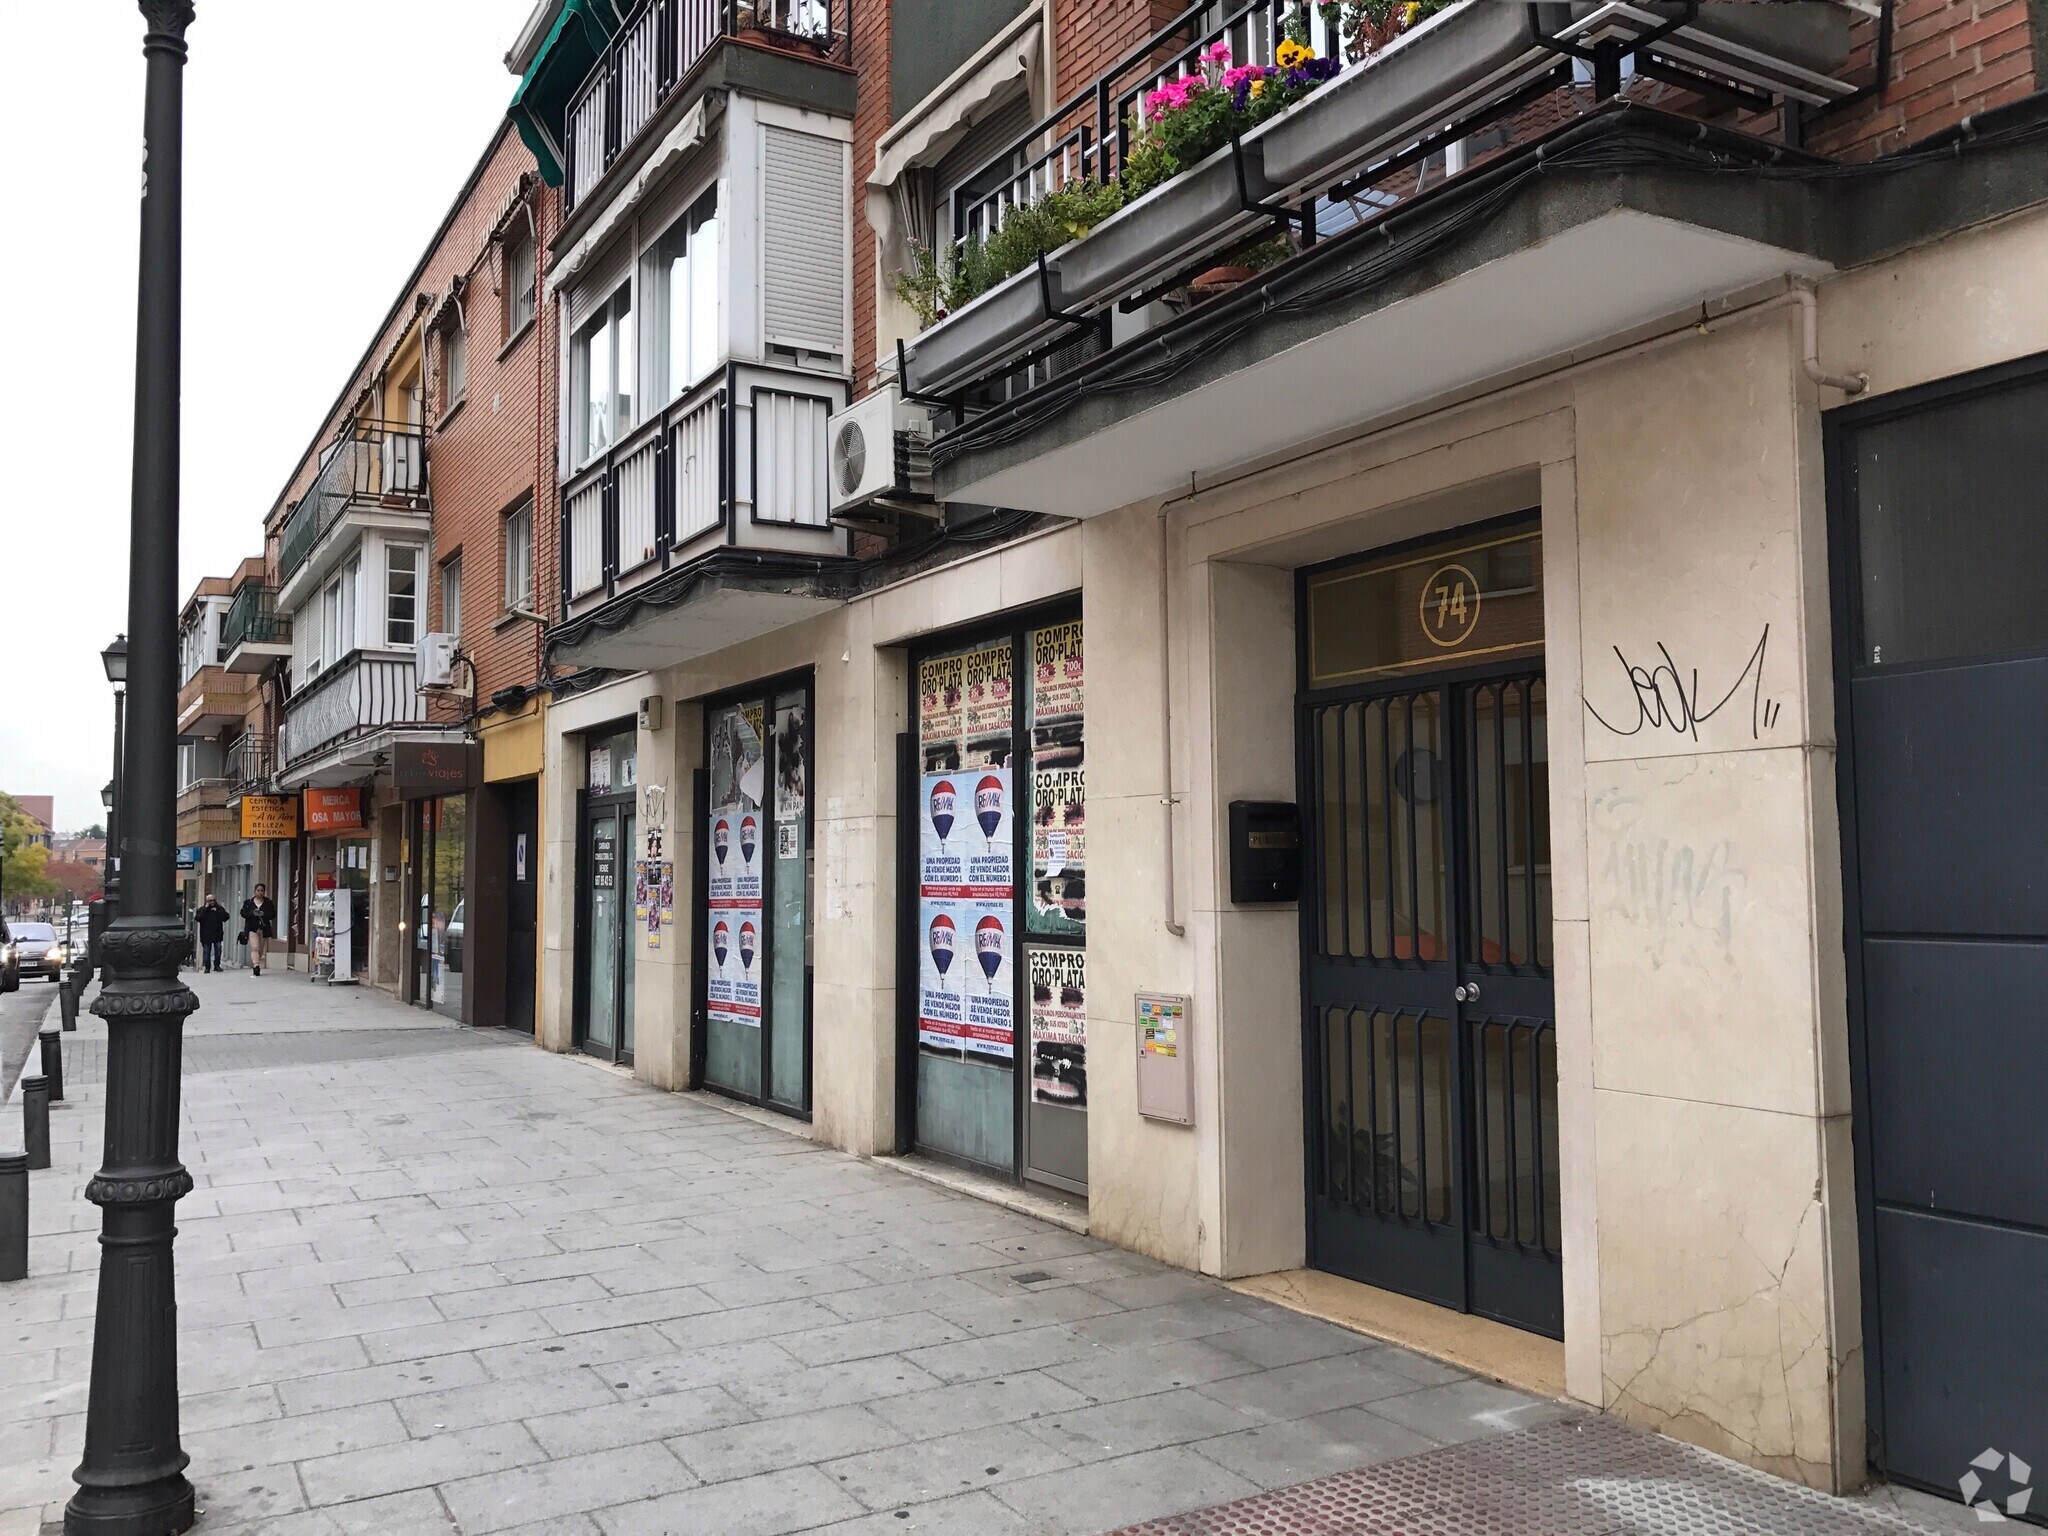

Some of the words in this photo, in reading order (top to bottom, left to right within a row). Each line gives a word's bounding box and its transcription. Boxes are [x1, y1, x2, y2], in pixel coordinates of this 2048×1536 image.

[1436, 582, 1468, 628] 74
[967, 647, 1012, 669] COMPRO
[1036, 644, 1055, 665] ORO
[922, 658, 963, 680] COMPRO
[967, 667, 984, 687] ORO
[986, 661, 1012, 683] PLATA
[922, 679, 937, 696] ORO
[939, 672, 963, 692] PLATA
[428, 768, 463, 781] viajes
[322, 794, 350, 806] MERCA
[978, 789, 1001, 809] RE/MAX
[1036, 788, 1055, 807] ORO
[257, 812, 265, 821] A
[312, 812, 329, 823] OSA
[333, 810, 362, 822] MAYOR
[971, 856, 980, 864] UNA
[982, 855, 1009, 864] PROPIEDAD
[970, 865, 976, 873] SE
[976, 865, 992, 873] VENDE
[992, 865, 1009, 873] MEJOR
[933, 931, 954, 948] RE/MAX
[978, 931, 1002, 949] RE/MAX
[1031, 951, 1084, 969] COMPRO
[1031, 967, 1052, 987] ORO
[1054, 968, 1086, 989] PLATA
[925, 990, 934, 998] UNA
[935, 992, 960, 1002] PROPIEDAD
[971, 996, 981, 1004] UNA
[982, 997, 1009, 1008] PROPIEDAD
[923, 1008, 933, 1016] CON
[930, 1000, 944, 1009] VENDE
[945, 1002, 960, 1011] MEJOR
[971, 1005, 976, 1013] SE
[977, 1006, 992, 1015] VENDE
[993, 1008, 1010, 1017] MEJOR
[969, 1014, 980, 1022] CON
